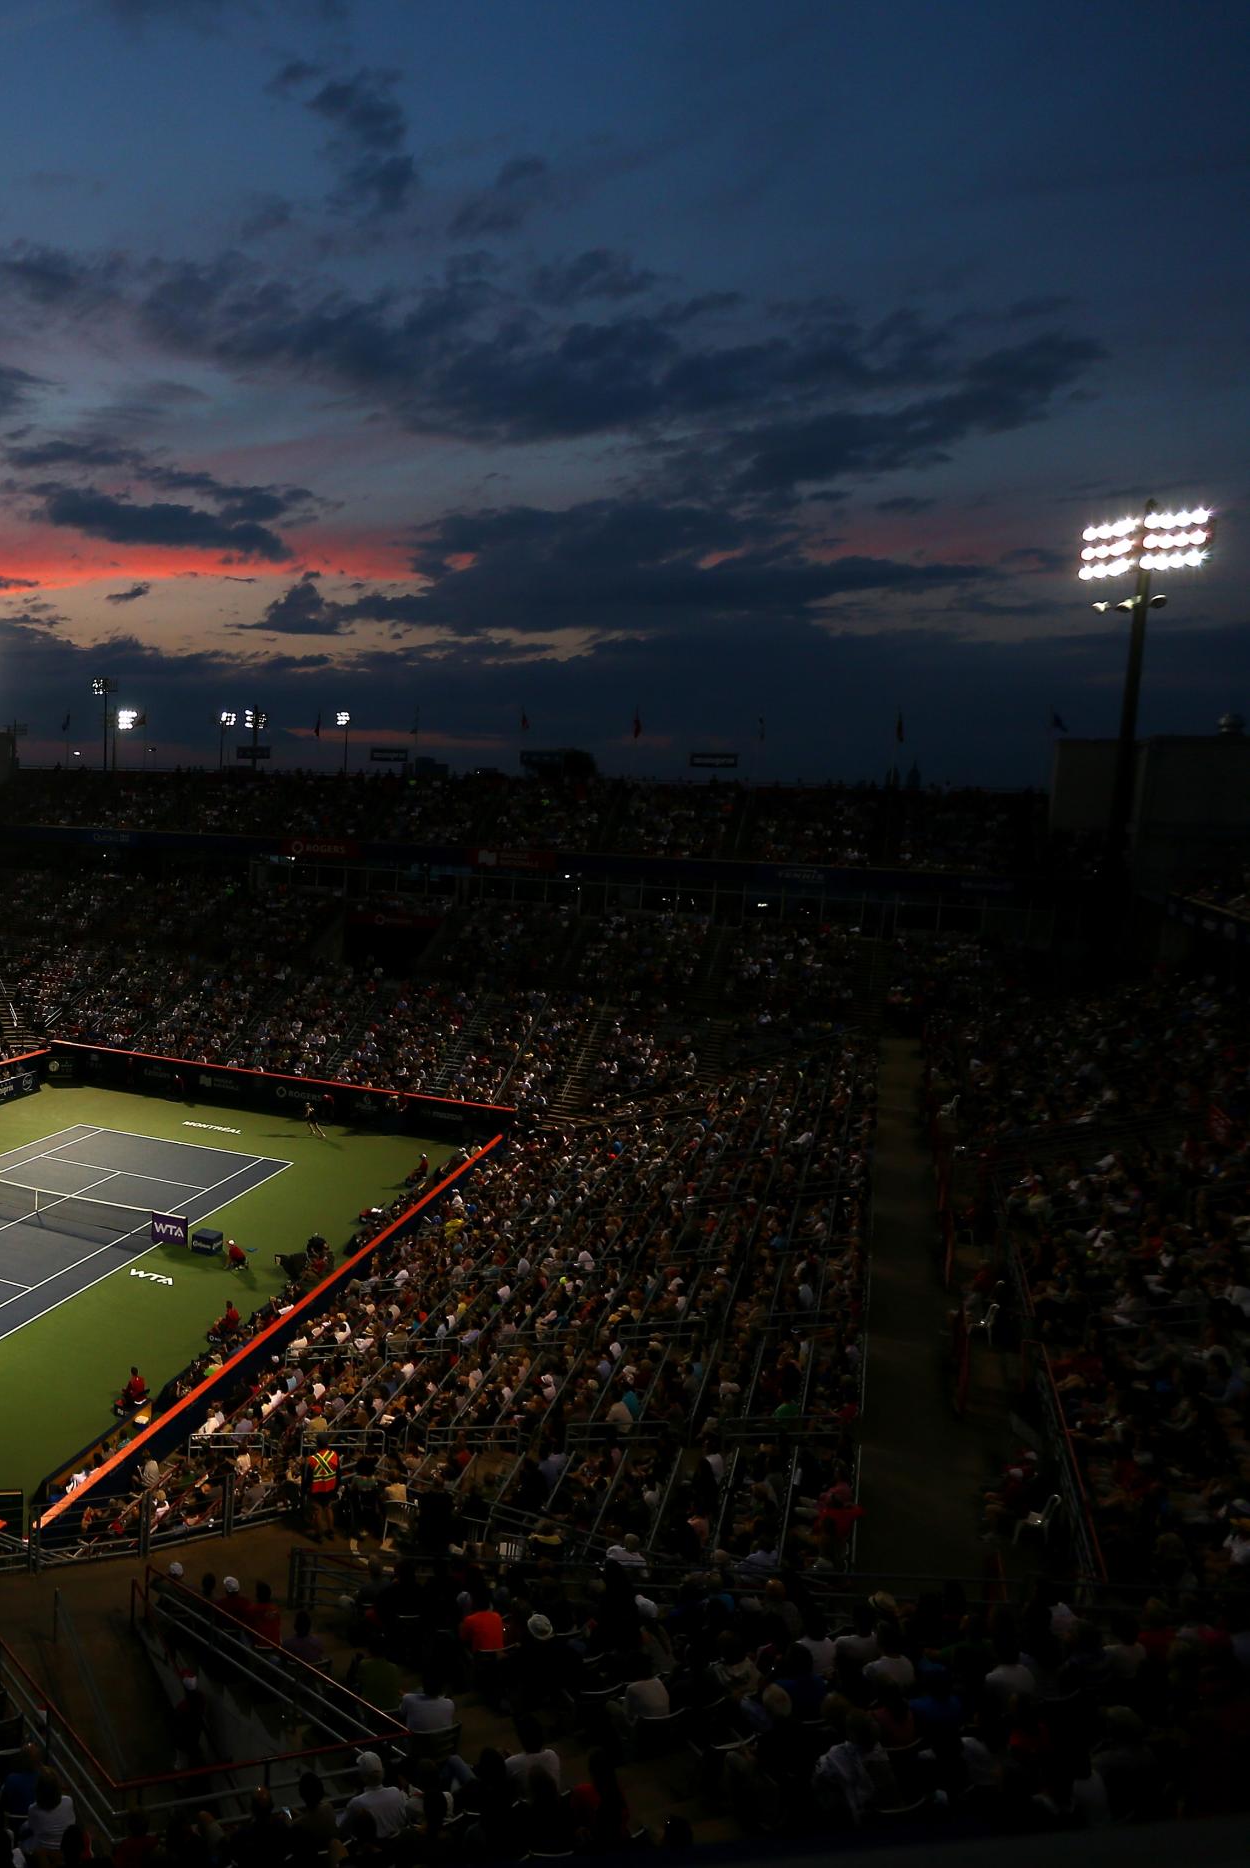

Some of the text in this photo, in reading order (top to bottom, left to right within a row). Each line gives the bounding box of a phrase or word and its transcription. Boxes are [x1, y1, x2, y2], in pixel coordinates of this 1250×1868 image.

[306, 844, 345, 855] ROGERS
[182, 1120, 242, 1135] MONTRÉAL
[154, 1221, 184, 1238] WTA
[130, 1268, 174, 1286] WTA
